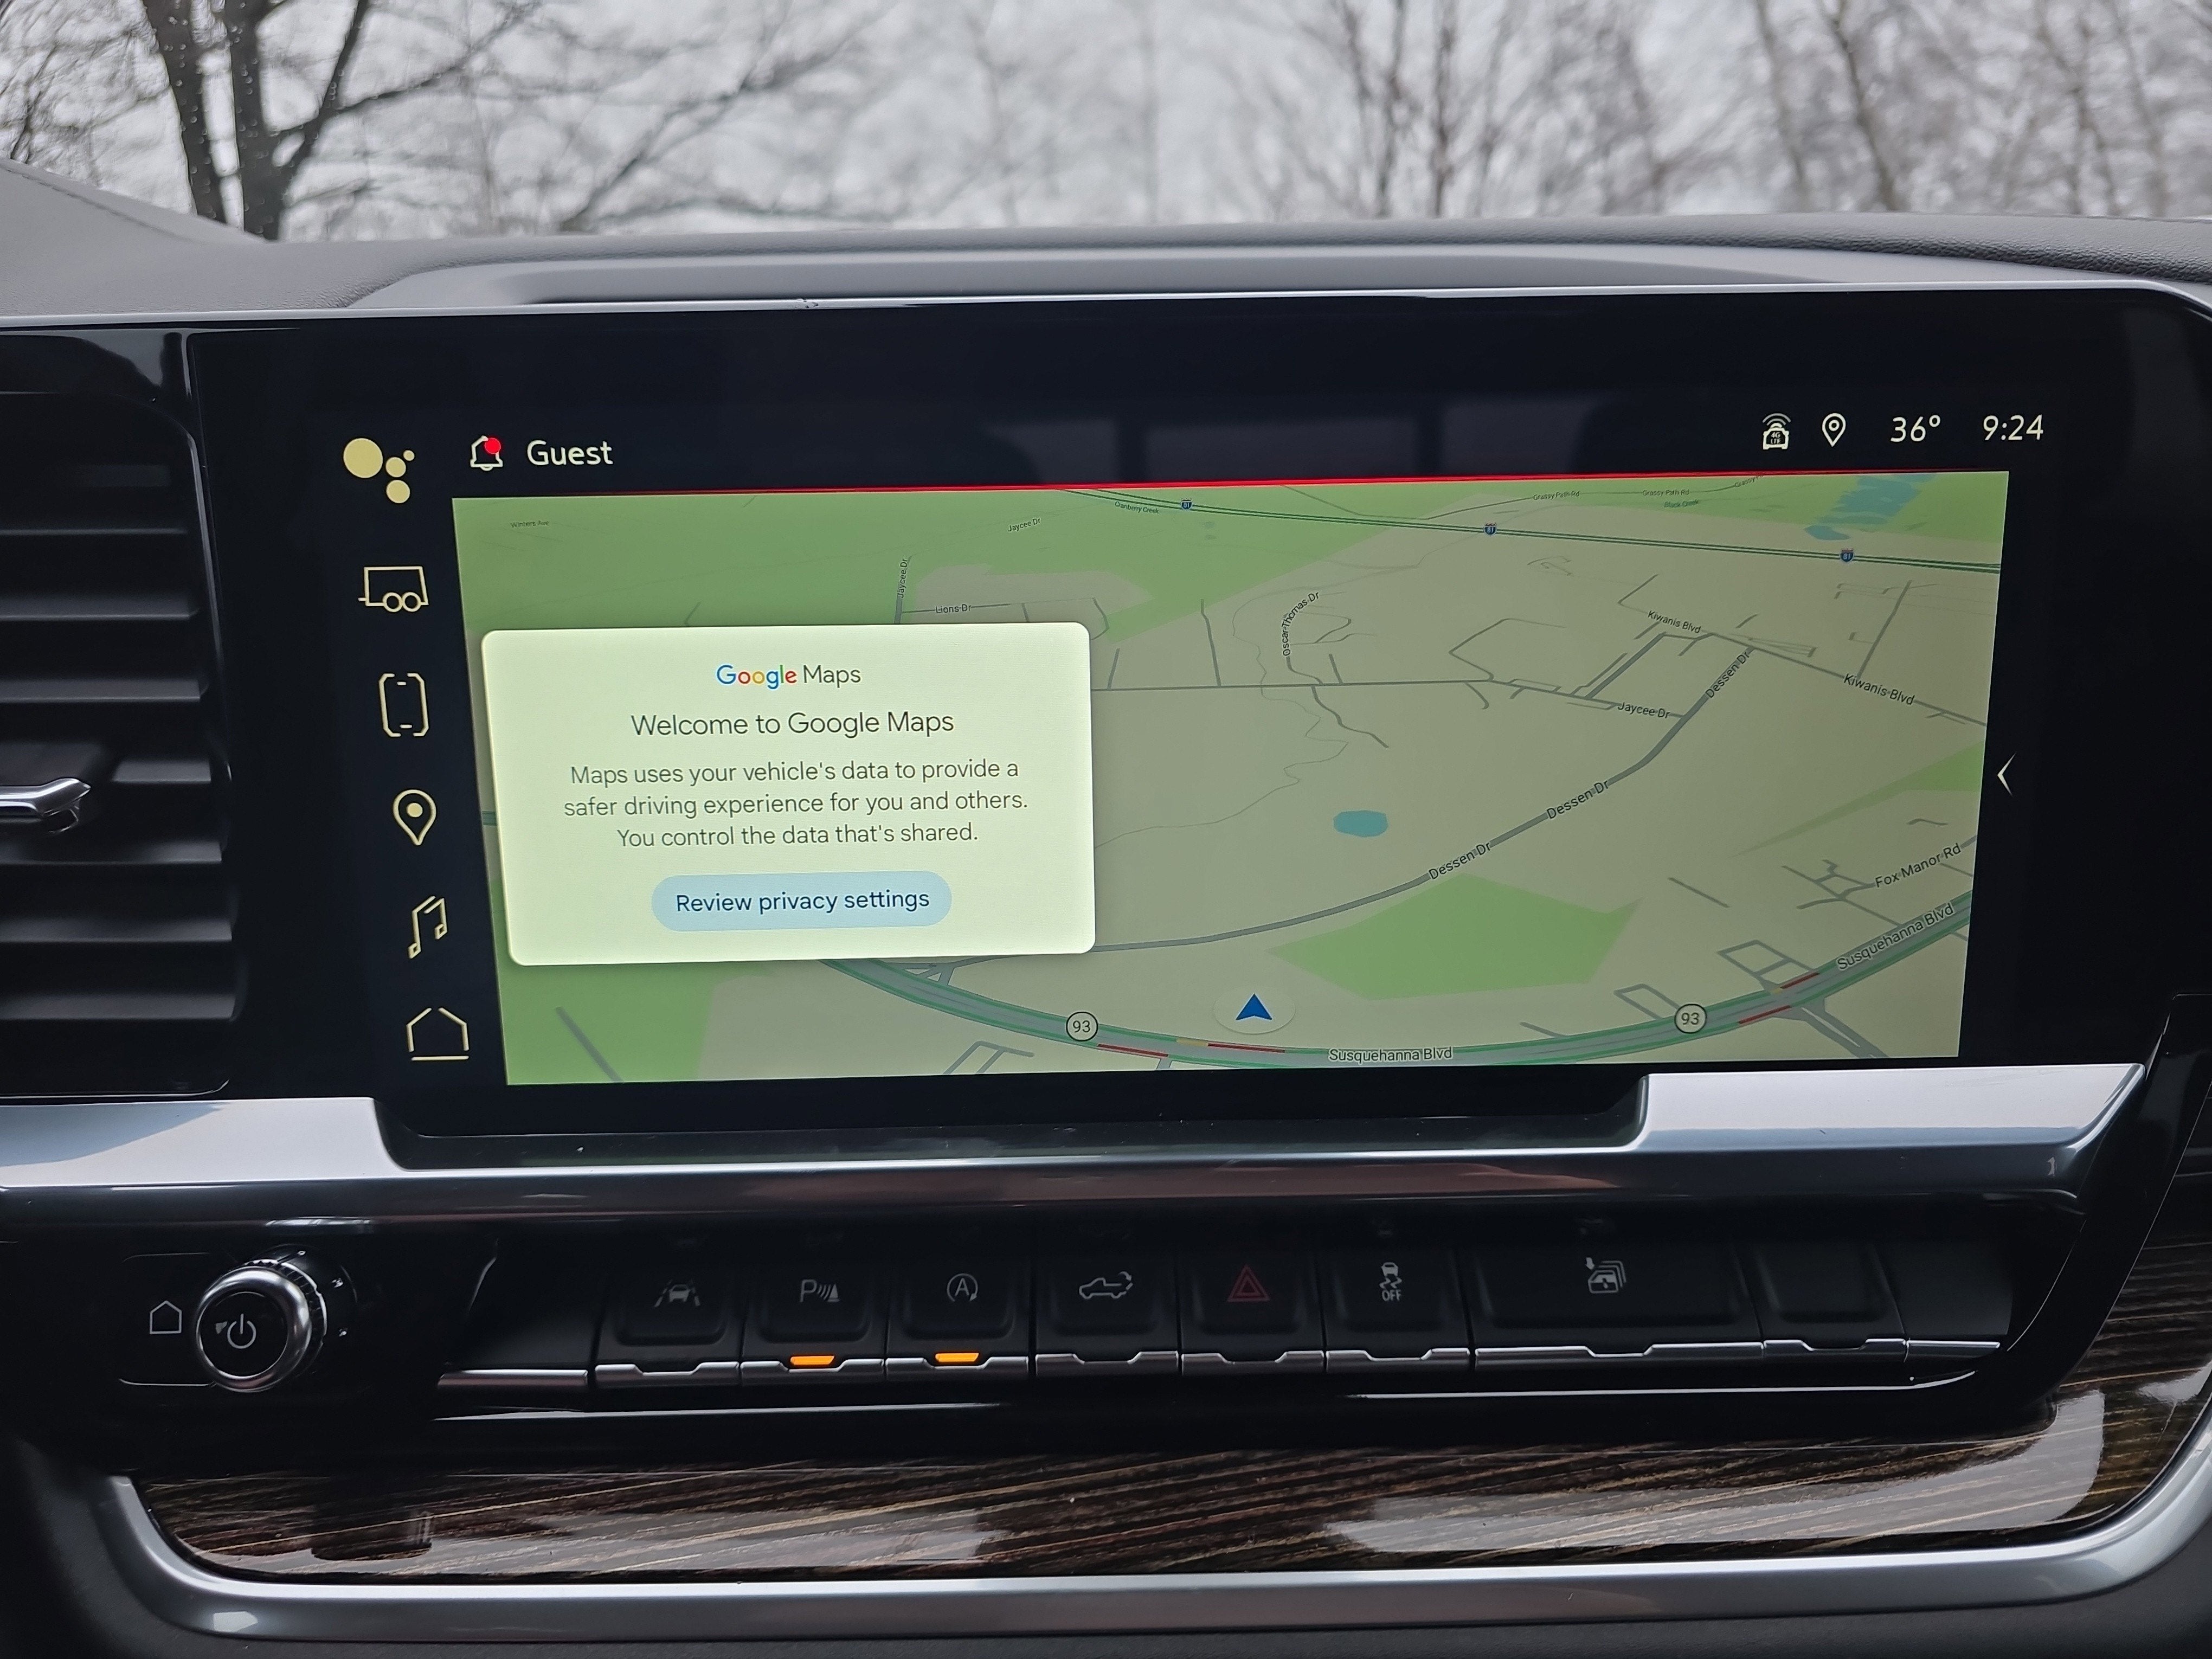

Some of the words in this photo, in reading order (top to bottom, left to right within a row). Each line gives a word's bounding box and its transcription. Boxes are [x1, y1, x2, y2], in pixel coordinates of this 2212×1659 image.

[1891, 415, 1941, 442] 36°
[1983, 415, 2044, 441] 9:24
[527, 440, 613, 465] Guest
[1008, 522, 1031, 532] Jaycee
[900, 558, 908, 568] Dr
[897, 570, 906, 599] Jaycee
[1308, 592, 1319, 602] Dr
[936, 606, 959, 614] Lions
[1282, 599, 1308, 627] Thomas
[1648, 610, 1680, 627] Kiwanis
[1682, 622, 1702, 633] Blvd
[1282, 629, 1291, 656] Oscar
[717, 665, 797, 689] Google
[803, 665, 860, 688] Maps
[1705, 663, 1739, 698] Dessen
[1737, 651, 1750, 664] Dr
[1844, 673, 1887, 696] Kiwanis
[1889, 689, 1915, 705] Blvd
[1618, 702, 1655, 716] Jaycee
[1657, 708, 1670, 718] Dr
[631, 715, 748, 735] Welcome
[756, 715, 780, 733] to
[788, 712, 879, 738] Google
[888, 711, 954, 737] Maps
[571, 767, 627, 789] Maps
[635, 769, 683, 782] uses
[689, 768, 736, 786] your
[743, 761, 835, 781] vehicle's
[843, 761, 888, 779] data
[895, 762, 915, 778] to
[923, 758, 1000, 783] provide
[1007, 764, 1018, 776] a
[565, 796, 617, 816] safer
[625, 796, 696, 819] driving
[704, 795, 823, 818] experience
[830, 792, 859, 811] for
[866, 798, 902, 815] you
[910, 791, 948, 809] and
[956, 790, 1027, 809] others.
[1547, 790, 1593, 819] Dessen
[1594, 780, 1609, 794] Dr
[617, 829, 654, 846] You
[662, 826, 734, 846] control
[741, 826, 775, 844] the
[783, 825, 828, 844] data
[835, 824, 894, 843] that's
[901, 822, 977, 841] shared.
[1429, 851, 1475, 879] Dessen
[1476, 841, 1491, 856] Dr
[1875, 872, 1900, 888] Fox
[1901, 853, 1941, 878] Manor
[1943, 843, 1962, 859] Rd
[677, 893, 751, 911] Review
[760, 892, 838, 915] privacy
[845, 890, 929, 911] settings
[1837, 921, 1924, 969] Susquehanna
[1924, 903, 1953, 926] Blvd
[1072, 1020, 1090, 1033] 93
[1681, 1012, 1700, 1026] 93
[1329, 1049, 1419, 1064] Susquehanna
[1424, 1046, 1452, 1059] Blvd
[955, 1279, 971, 1297] A
[1381, 1289, 1402, 1301] OFF
